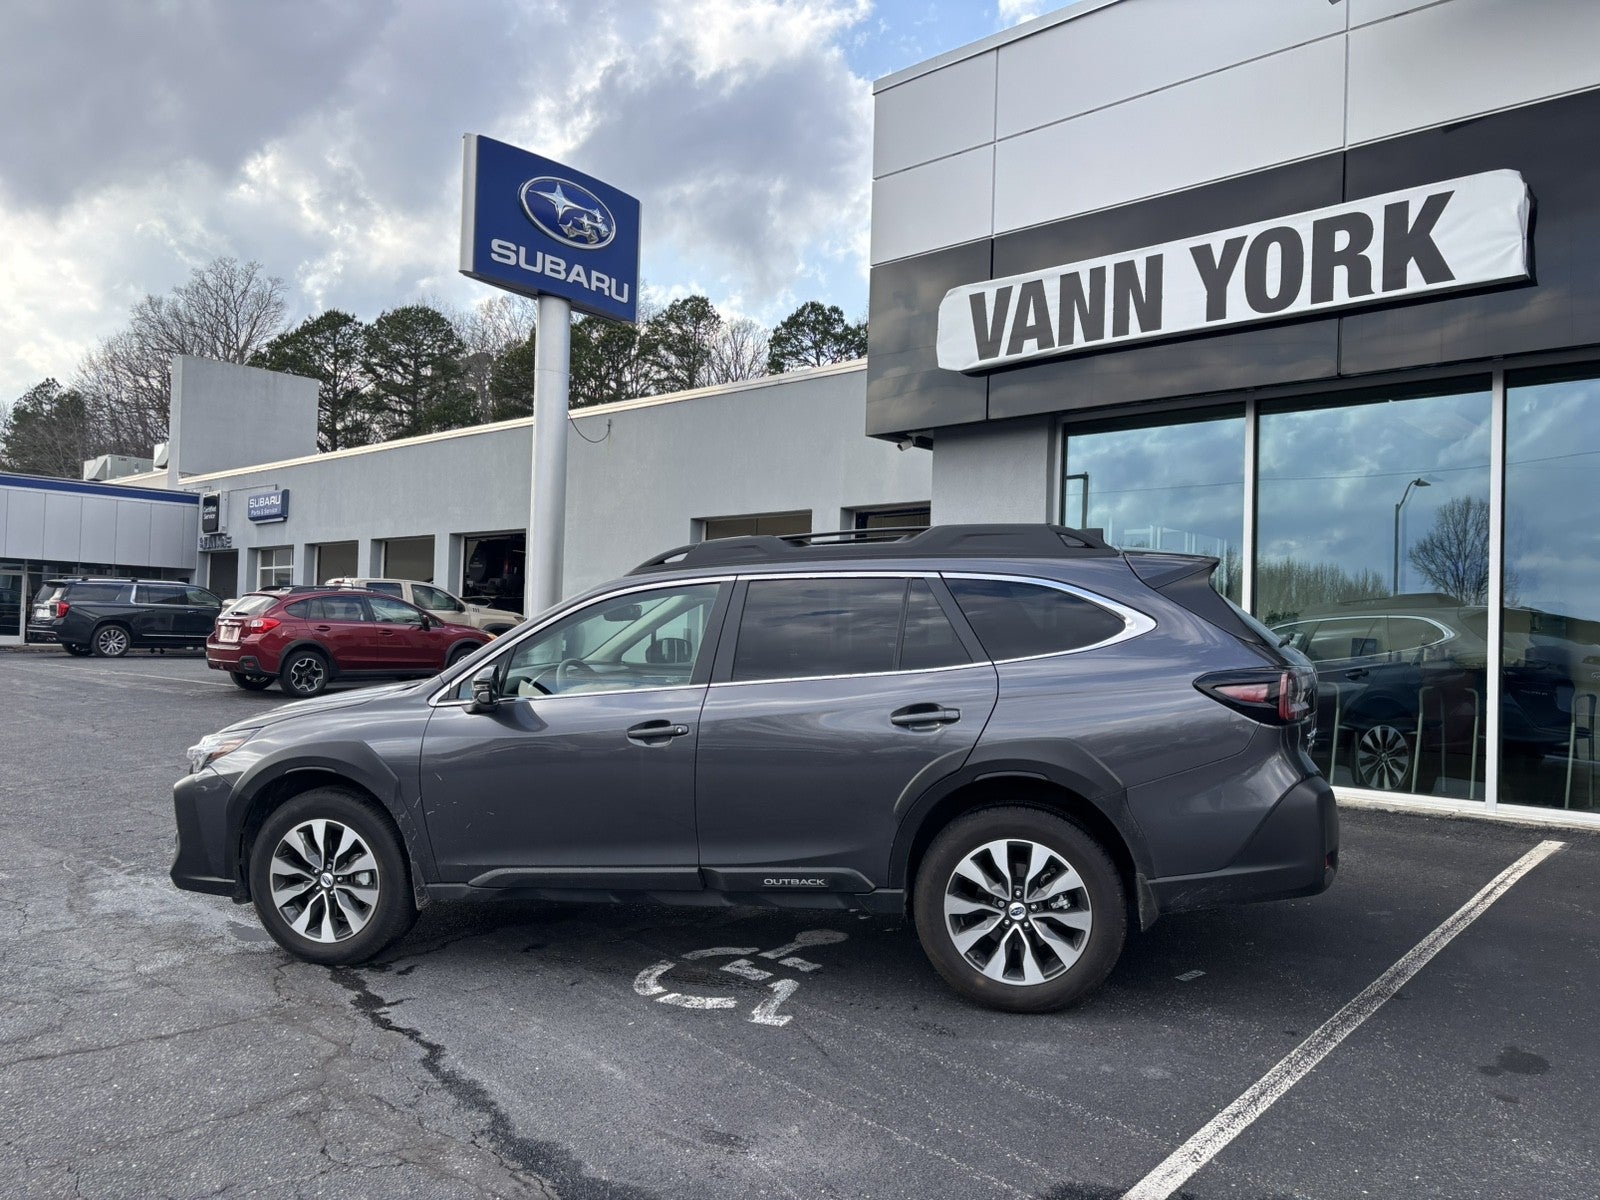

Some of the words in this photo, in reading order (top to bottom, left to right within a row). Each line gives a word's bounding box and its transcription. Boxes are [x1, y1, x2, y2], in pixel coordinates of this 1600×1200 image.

[490, 238, 630, 304] SUBARU
[969, 253, 1163, 361] VANN
[1189, 190, 1456, 323] YORK
[249, 495, 281, 508] SUBARU
[763, 878, 826, 886] OUTBACK
